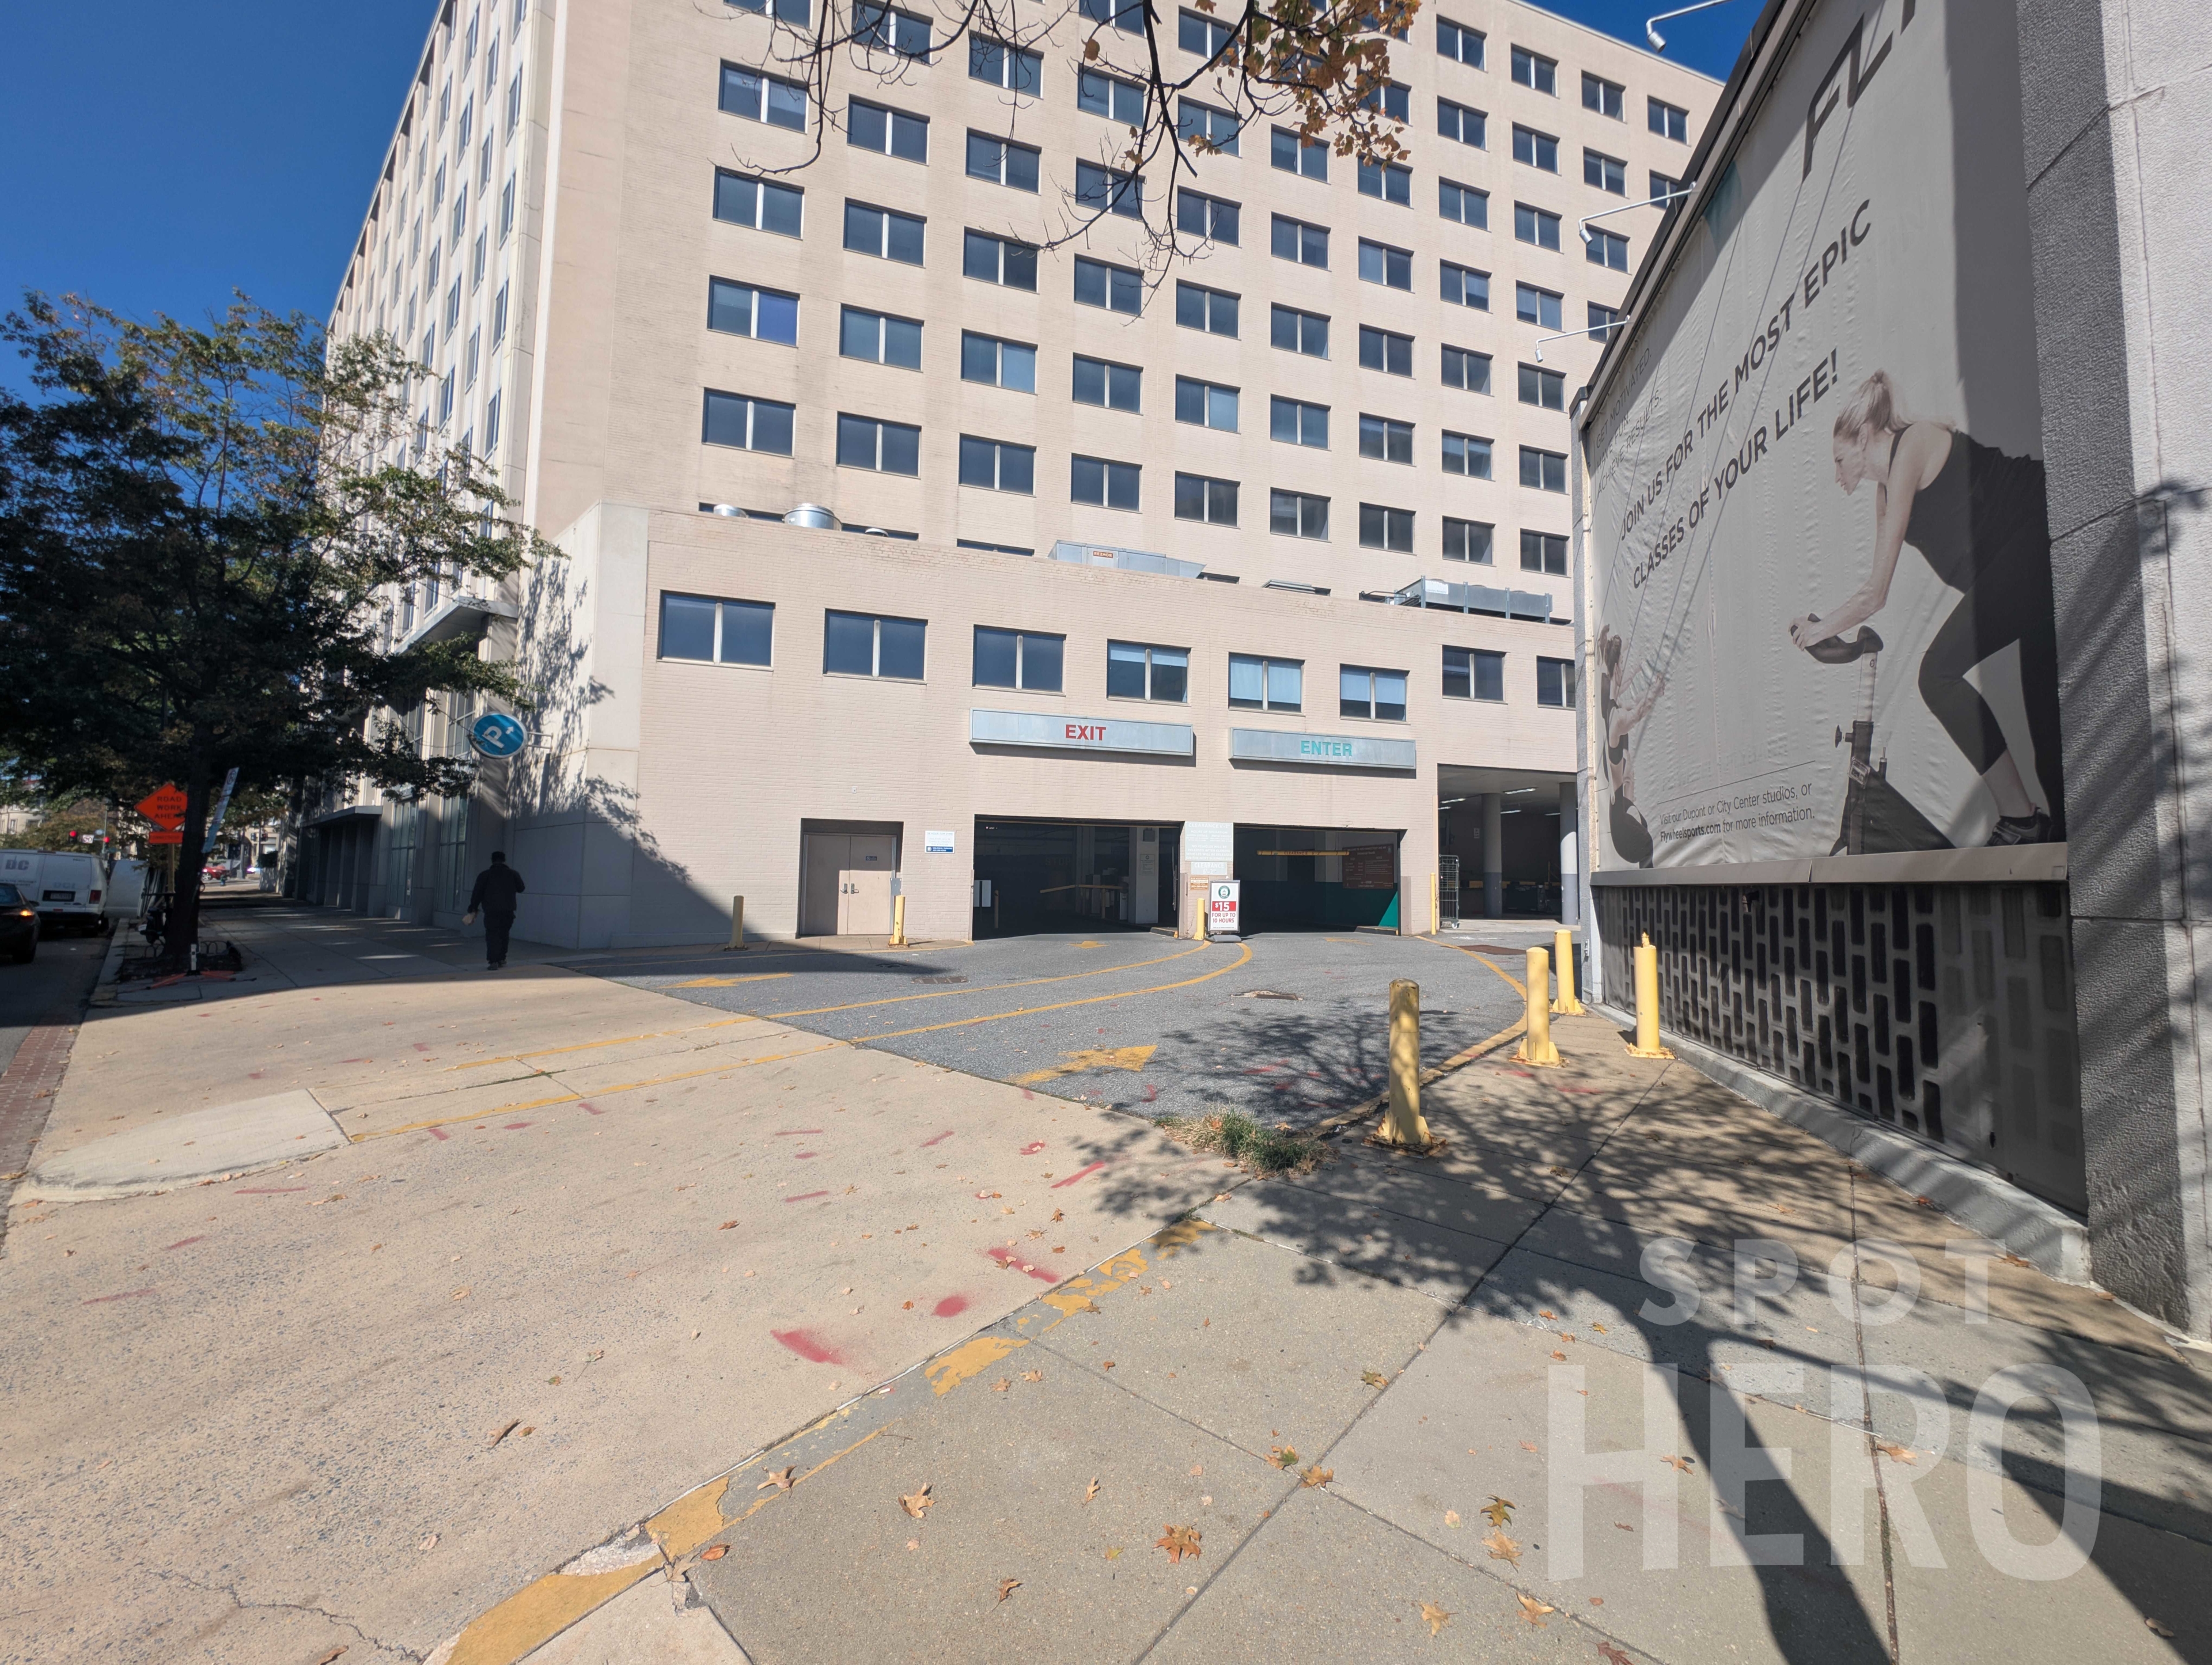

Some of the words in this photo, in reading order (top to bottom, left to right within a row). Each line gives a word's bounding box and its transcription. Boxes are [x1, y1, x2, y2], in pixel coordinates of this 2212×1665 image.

[1802, 0, 1916, 184] FL
[1622, 494, 1644, 541] JOIN
[1647, 471, 1662, 506] US
[1666, 429, 1693, 483] FOR
[1697, 379, 1728, 439] THE
[1735, 292, 1795, 395] MOST
[1804, 199, 1871, 309] EPIC
[1596, 419, 1608, 448] GET
[1610, 347, 1652, 422] MOTIVATED.
[1597, 445, 1625, 497] ACHIEVE
[1633, 517, 1684, 589] CLASSES
[1688, 487, 1710, 529] OF
[1714, 426, 1768, 500] YOUR
[1775, 347, 1838, 441] LIFE!
[482, 726, 505, 748] P
[1065, 723, 1107, 741] EXIT
[1301, 740, 1353, 757] ENTER
[1660, 813, 1671, 825] Visit
[1672, 812, 1681, 822] our
[1683, 806, 1706, 821] Dupont
[1707, 804, 1715, 814] or
[1717, 800, 1731, 814] City
[1733, 795, 1760, 810] Center
[1762, 785, 1798, 804] studios,
[1801, 783, 1812, 796] or
[1660, 822, 1721, 843] Flywheelsports.com
[1722, 819, 1733, 832] for
[1736, 817, 1756, 830] more
[1758, 806, 1815, 828] information.
[1215, 901, 1230, 911] $15
